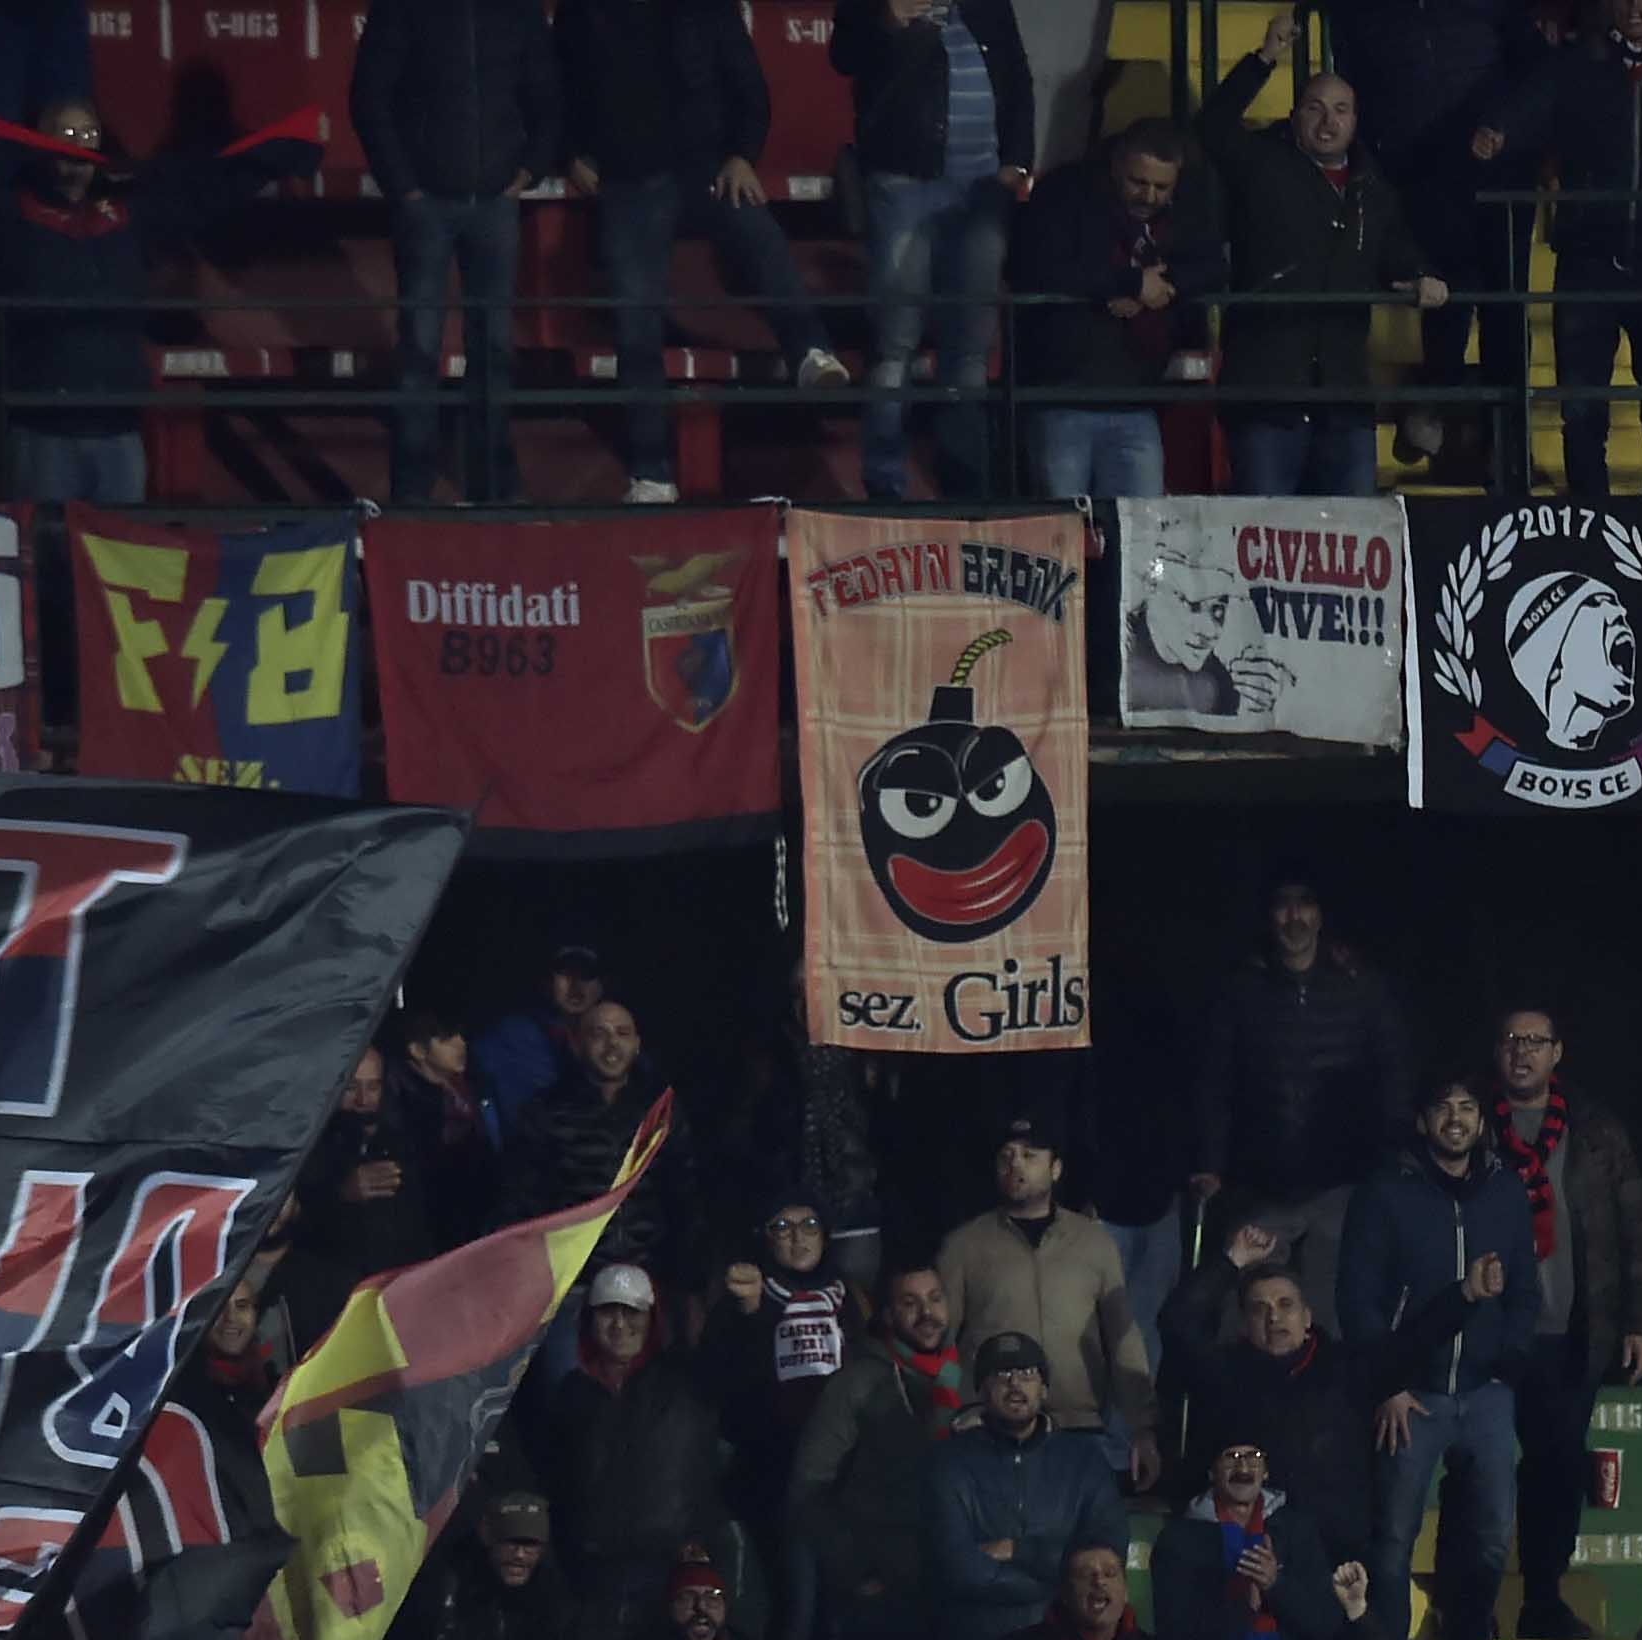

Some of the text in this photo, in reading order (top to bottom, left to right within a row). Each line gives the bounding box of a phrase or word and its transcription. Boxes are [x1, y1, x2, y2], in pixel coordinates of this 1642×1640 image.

[1518, 504, 1596, 540] 2017
[407, 579, 581, 628] Diffidati
[1522, 585, 1567, 632] BOYS CE
[1515, 771, 1631, 800] BOYS CE
[838, 955, 1086, 1042] sez. Girls
